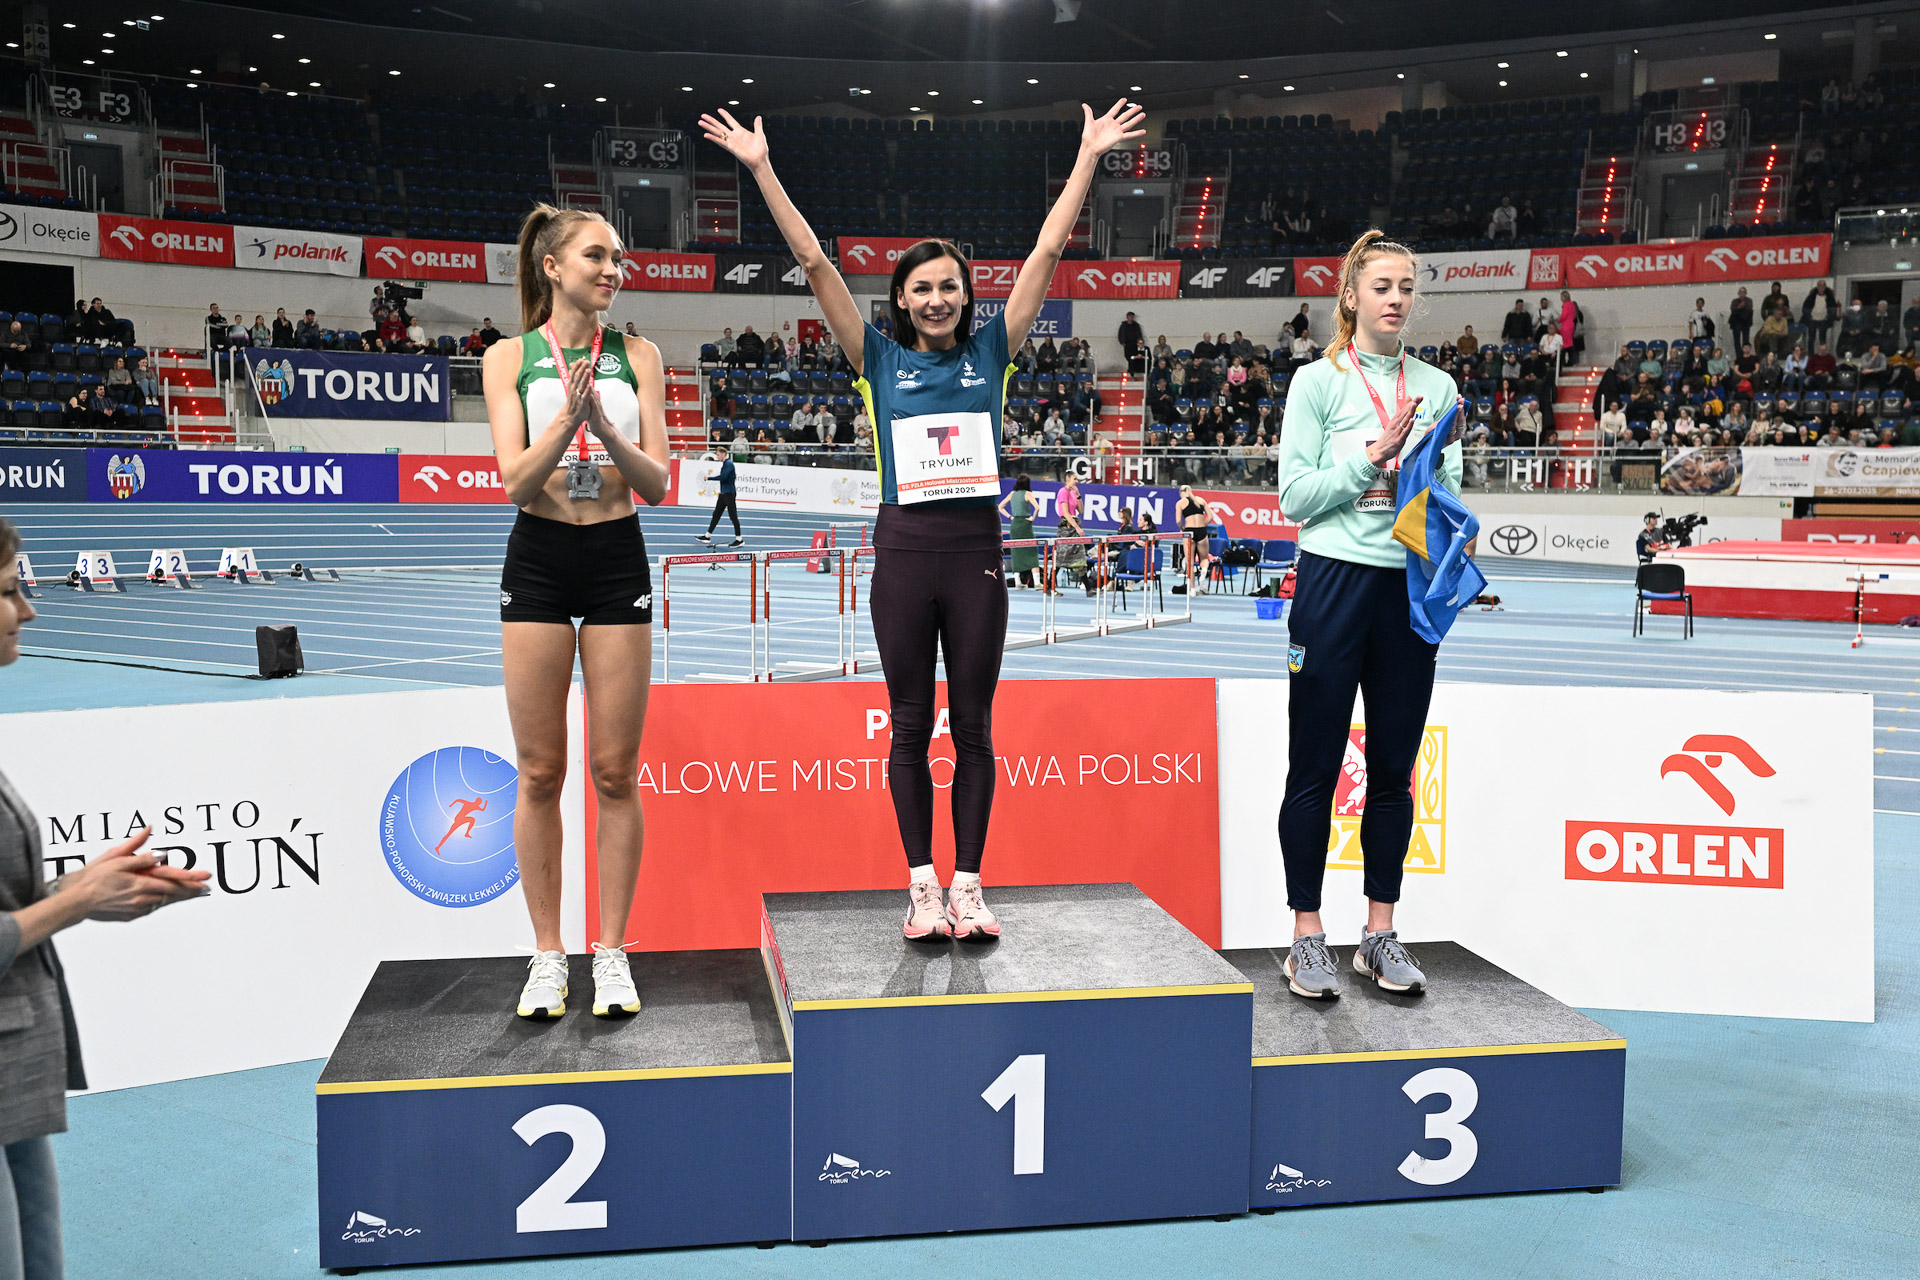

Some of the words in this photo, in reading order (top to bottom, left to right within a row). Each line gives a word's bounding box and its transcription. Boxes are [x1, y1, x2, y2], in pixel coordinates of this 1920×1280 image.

[50, 86, 82, 110] E3
[100, 92, 131, 116] F3
[1655, 123, 1687, 146] H3
[610, 140, 637, 160] F3
[649, 142, 679, 163] G3
[1104, 151, 1133, 171] G3
[1144, 151, 1172, 171] H3
[33, 223, 91, 242] Okęcie
[151, 231, 224, 253] ORLEN
[411, 250, 477, 269] ORLEN
[1614, 254, 1684, 273] ORLEN
[1745, 247, 1820, 266] ORLEN
[646, 263, 707, 280] ORLEN
[724, 263, 763, 284] 4F
[1111, 271, 1171, 287] ORLEN
[1189, 267, 1228, 288] 4F
[1246, 266, 1286, 288] 4F
[298, 362, 440, 403] TORUŃ
[919, 457, 973, 470] TRYUMF
[1070, 457, 1102, 480] G1
[1124, 457, 1153, 480] H1
[1875, 455, 1920, 463] Memoria
[189, 458, 343, 495] TORUŃ
[457, 471, 505, 488] ORL
[735, 473, 781, 484] inisterstwo
[1511, 459, 1543, 483] H1
[735, 486, 754, 494] ortu
[760, 486, 798, 497] Turystyki
[923, 486, 953, 497] TORUŃ
[955, 486, 977, 494] 2025
[924, 479, 946, 487] Halowe
[946, 477, 979, 485] Mistrzostwa
[1031, 490, 1164, 525] TRUŃ
[1358, 498, 1388, 508] TORUŃ
[1552, 533, 1610, 552] Okęcie
[80, 558, 88, 575] 3
[98, 558, 109, 575] 3
[154, 556, 163, 570] 2
[171, 556, 182, 573] 2
[225, 554, 231, 568] 1
[241, 554, 250, 569] 1
[637, 760, 778, 794] ALOWE
[1079, 752, 1203, 787] POLSKI
[47, 800, 260, 846] MIASTO
[384, 794, 426, 893] KUJAWSKO-POMORSKI
[425, 887, 468, 904] ZWIĄZEK
[468, 879, 506, 902] LEKKIEJ
[1575, 829, 1770, 880] ORLEN
[980, 1053, 1046, 1175] 1
[1397, 1067, 1479, 1186] 3
[511, 1104, 608, 1233] 2
[818, 1167, 892, 1182] arena
[1265, 1178, 1332, 1191] arena
[341, 1225, 422, 1241] arena
[353, 1235, 375, 1243] TORUŃ
